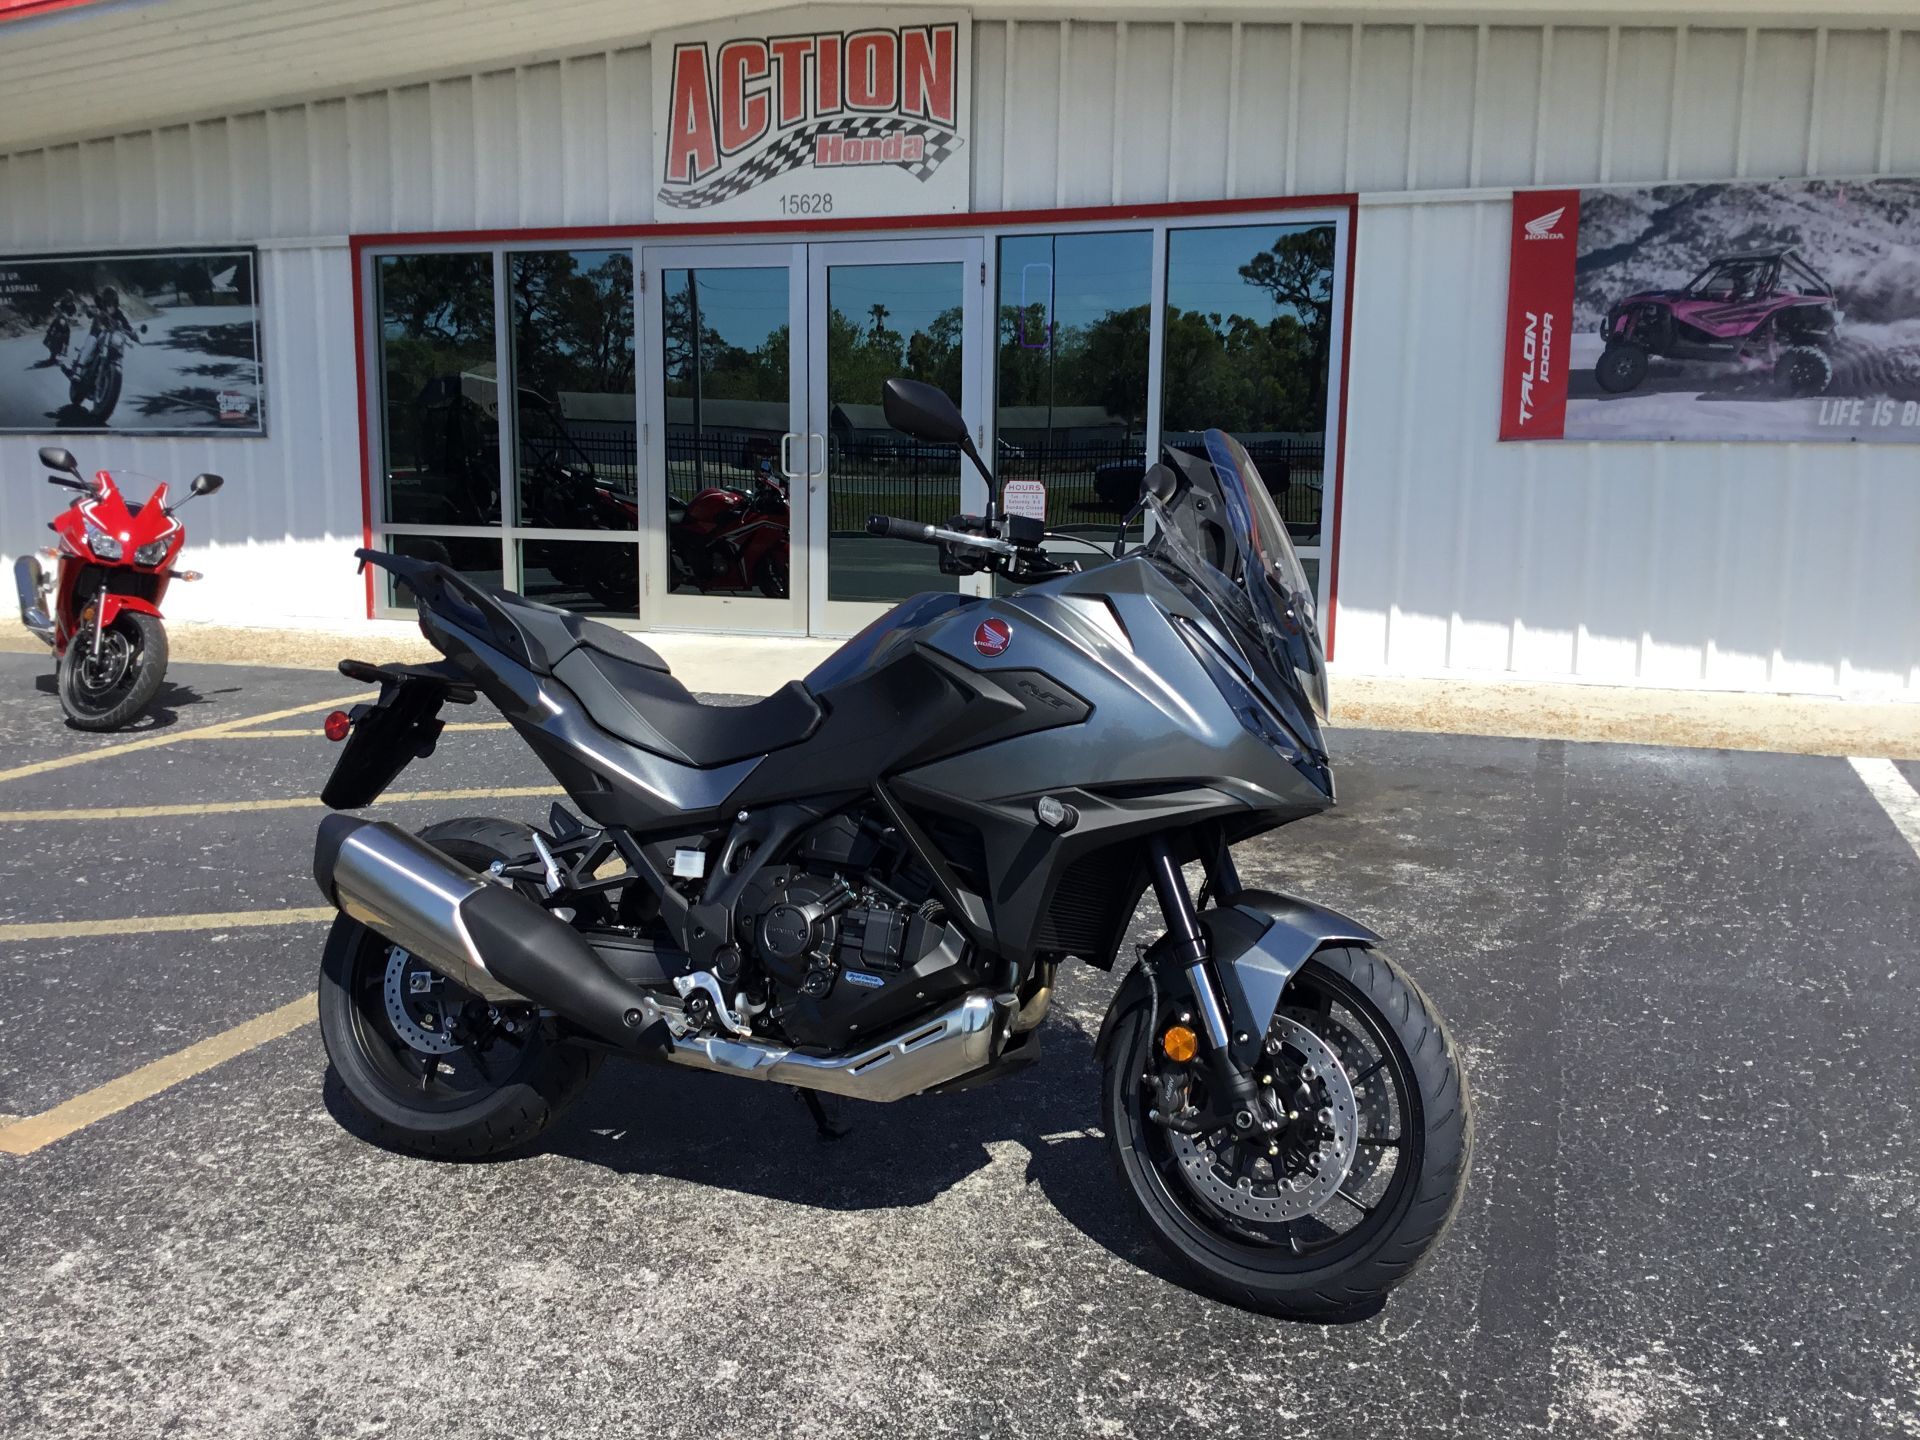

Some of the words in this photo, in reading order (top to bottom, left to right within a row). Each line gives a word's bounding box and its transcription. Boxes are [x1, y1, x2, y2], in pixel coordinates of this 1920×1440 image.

[664, 22, 959, 186] ACTION
[814, 130, 925, 168] Honda
[779, 193, 833, 215] 15628
[1524, 232, 1565, 241] HONDA
[1539, 313, 1553, 384] 1000R
[1518, 312, 1538, 426] TALON
[1818, 400, 1863, 426] LIFE
[1871, 401, 1897, 426] IS
